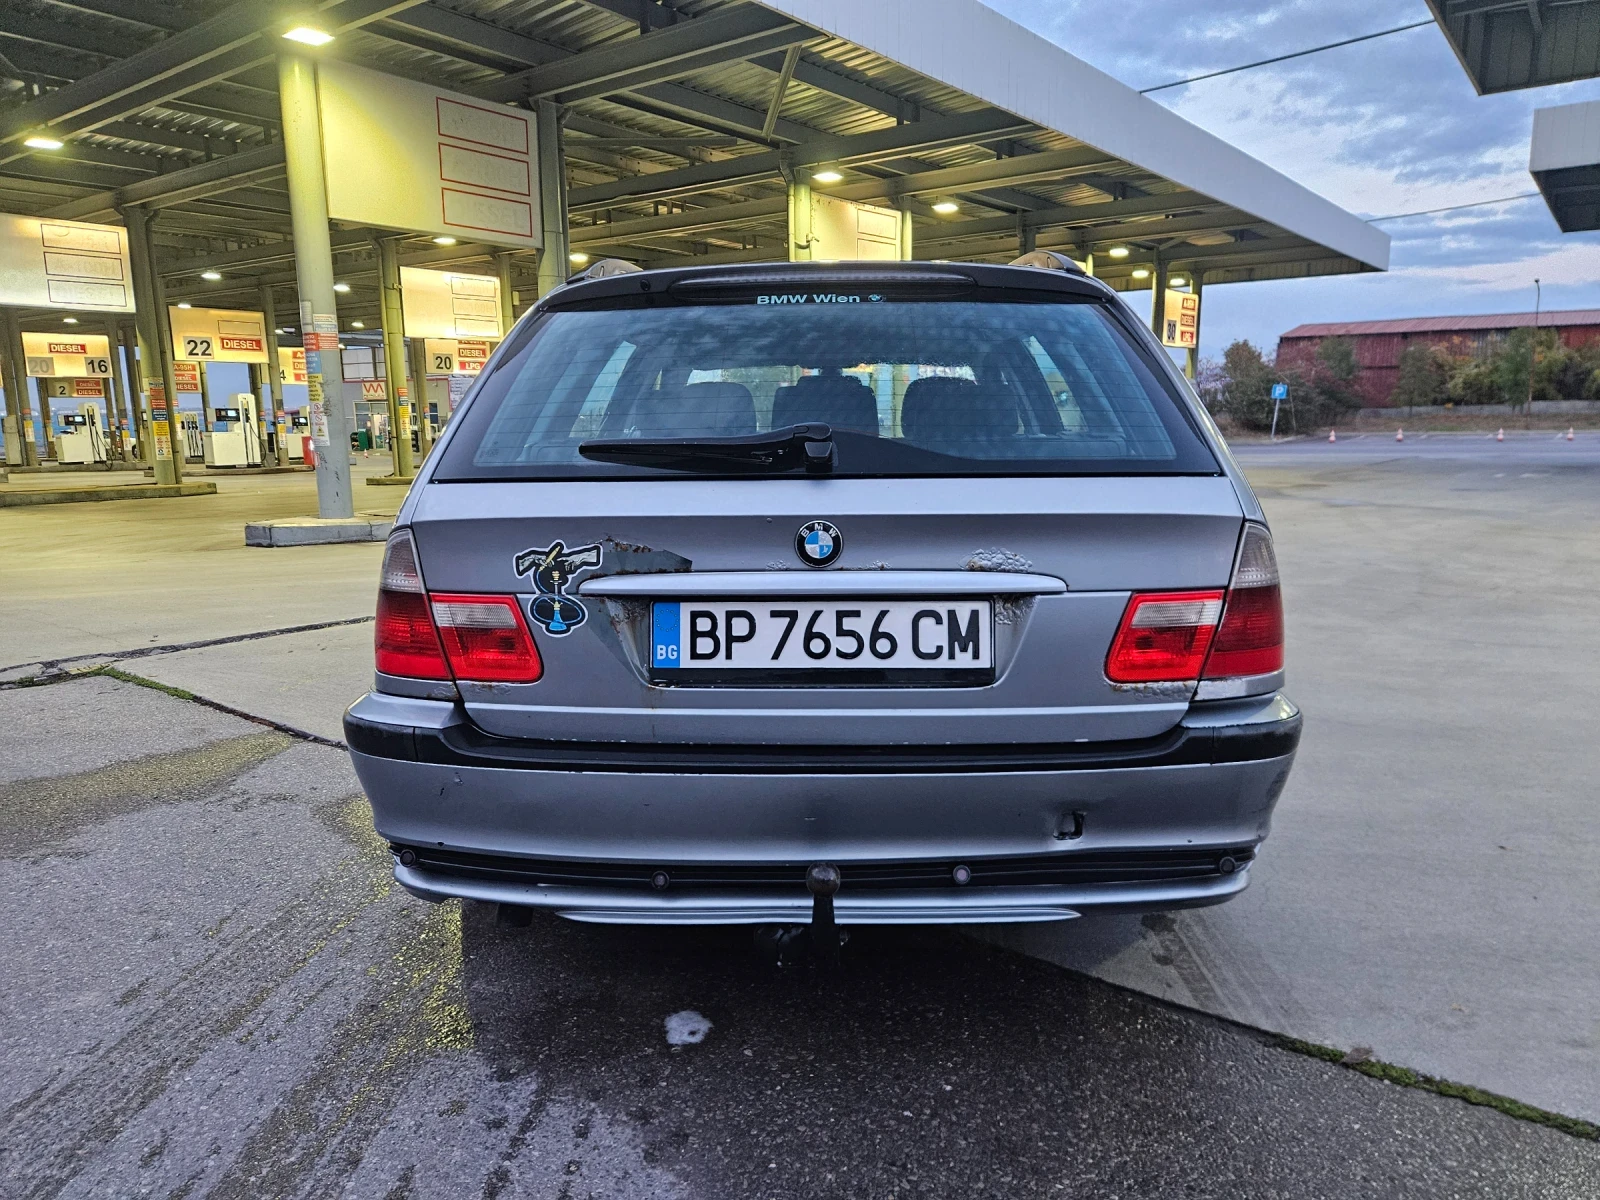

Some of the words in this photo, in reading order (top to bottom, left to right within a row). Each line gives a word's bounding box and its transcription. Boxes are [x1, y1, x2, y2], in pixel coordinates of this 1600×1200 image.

[757, 295, 808, 305] BMW
[813, 294, 860, 303] Wien
[50, 344, 85, 353] DIESEL
[187, 339, 212, 357] 22
[223, 339, 260, 350] DIESEL
[459, 348, 485, 357] DIESEL
[29, 359, 50, 374] 20
[87, 359, 109, 374] 16
[173, 363, 193, 371] A-95H
[435, 356, 452, 370] 20
[58, 386, 67, 395] 2
[1275, 386, 1284, 396] P
[801, 522, 838, 539] BMW
[689, 609, 757, 661] BP
[769, 609, 899, 661] 7656
[911, 609, 981, 661] CM
[657, 645, 678, 660] BG
